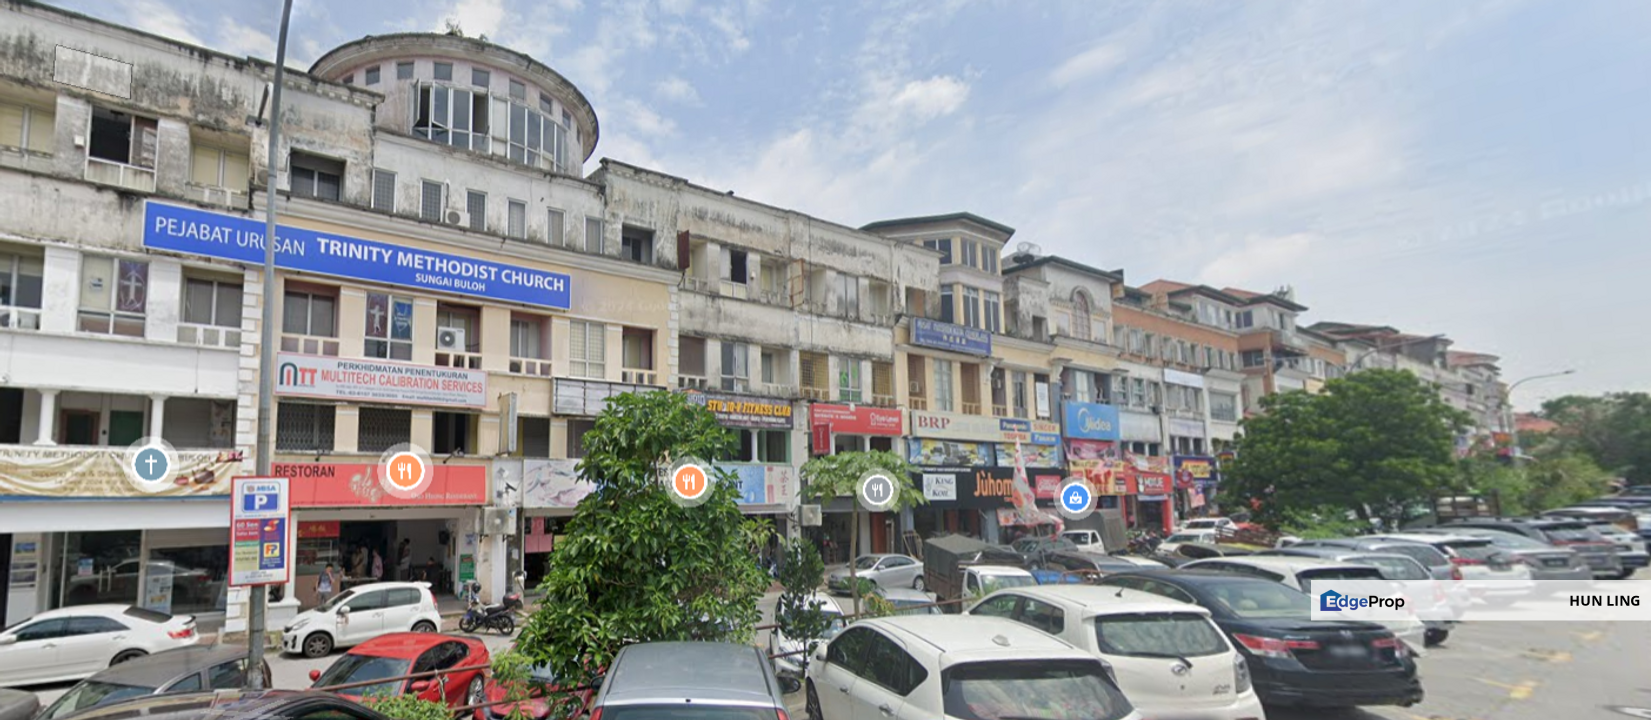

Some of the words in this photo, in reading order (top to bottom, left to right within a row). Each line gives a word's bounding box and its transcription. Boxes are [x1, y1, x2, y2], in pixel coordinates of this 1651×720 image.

[155, 216, 233, 244] PEJABAT
[317, 237, 392, 263] TRINITY
[397, 251, 499, 281] METHODIST
[501, 269, 565, 292] CHURCH
[415, 273, 453, 287] SUNGAI
[454, 278, 486, 292] BULOH
[337, 361, 403, 375] PERKHIDMATAN
[404, 368, 469, 380] PENENTUKURAN
[321, 369, 376, 386] MULTITECH
[378, 374, 440, 391] CALIBRATION
[442, 379, 483, 394] SERVICES
[742, 402, 773, 415] FITNESS
[773, 405, 792, 417] CLUB
[918, 415, 950, 429] BRP
[274, 465, 336, 478] RESTORAN
[935, 476, 954, 485] KING
[255, 494, 268, 510] P
